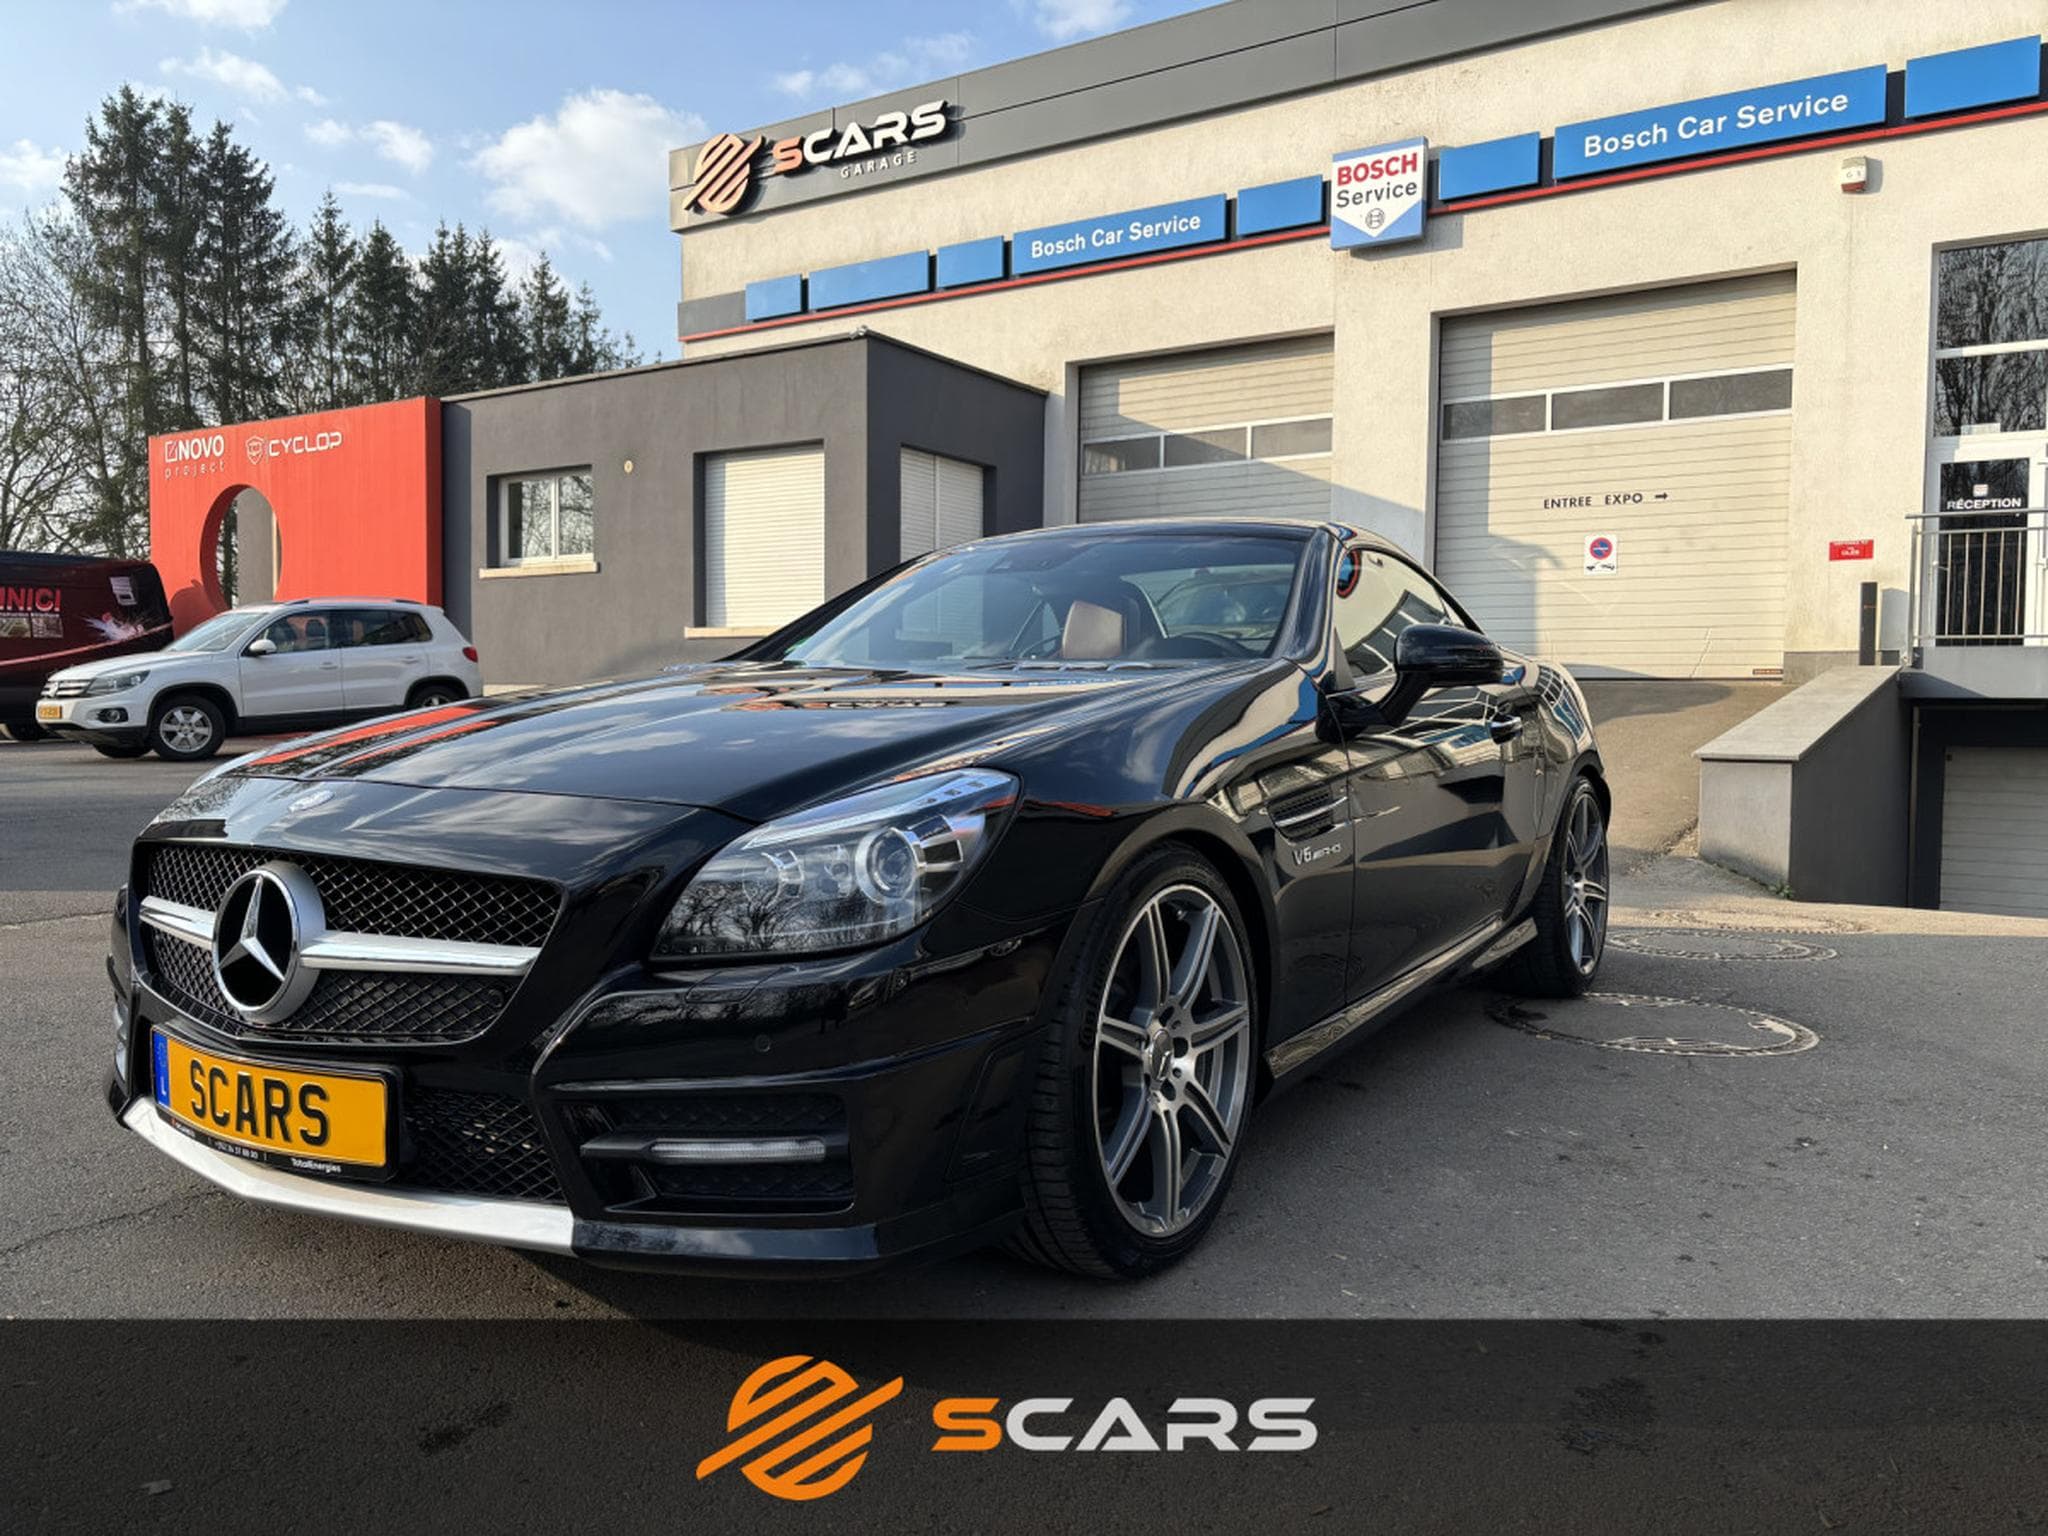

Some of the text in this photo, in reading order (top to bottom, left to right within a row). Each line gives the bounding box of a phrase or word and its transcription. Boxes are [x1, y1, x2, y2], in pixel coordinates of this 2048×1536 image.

[772, 100, 947, 174] SCARS
[1583, 94, 1849, 158] Bosch Car Service
[840, 150, 918, 179] GARAGE
[1337, 152, 1418, 187] BOSCH
[1336, 181, 1418, 209] Service
[1031, 215, 1201, 259] Bosch Car Service
[268, 431, 343, 457] CYCLOP
[164, 460, 225, 480] project
[1543, 492, 1644, 510] ENTREE EXPO
[1946, 496, 2022, 510] RÉCEPTION
[190, 1058, 330, 1147] SCARS
